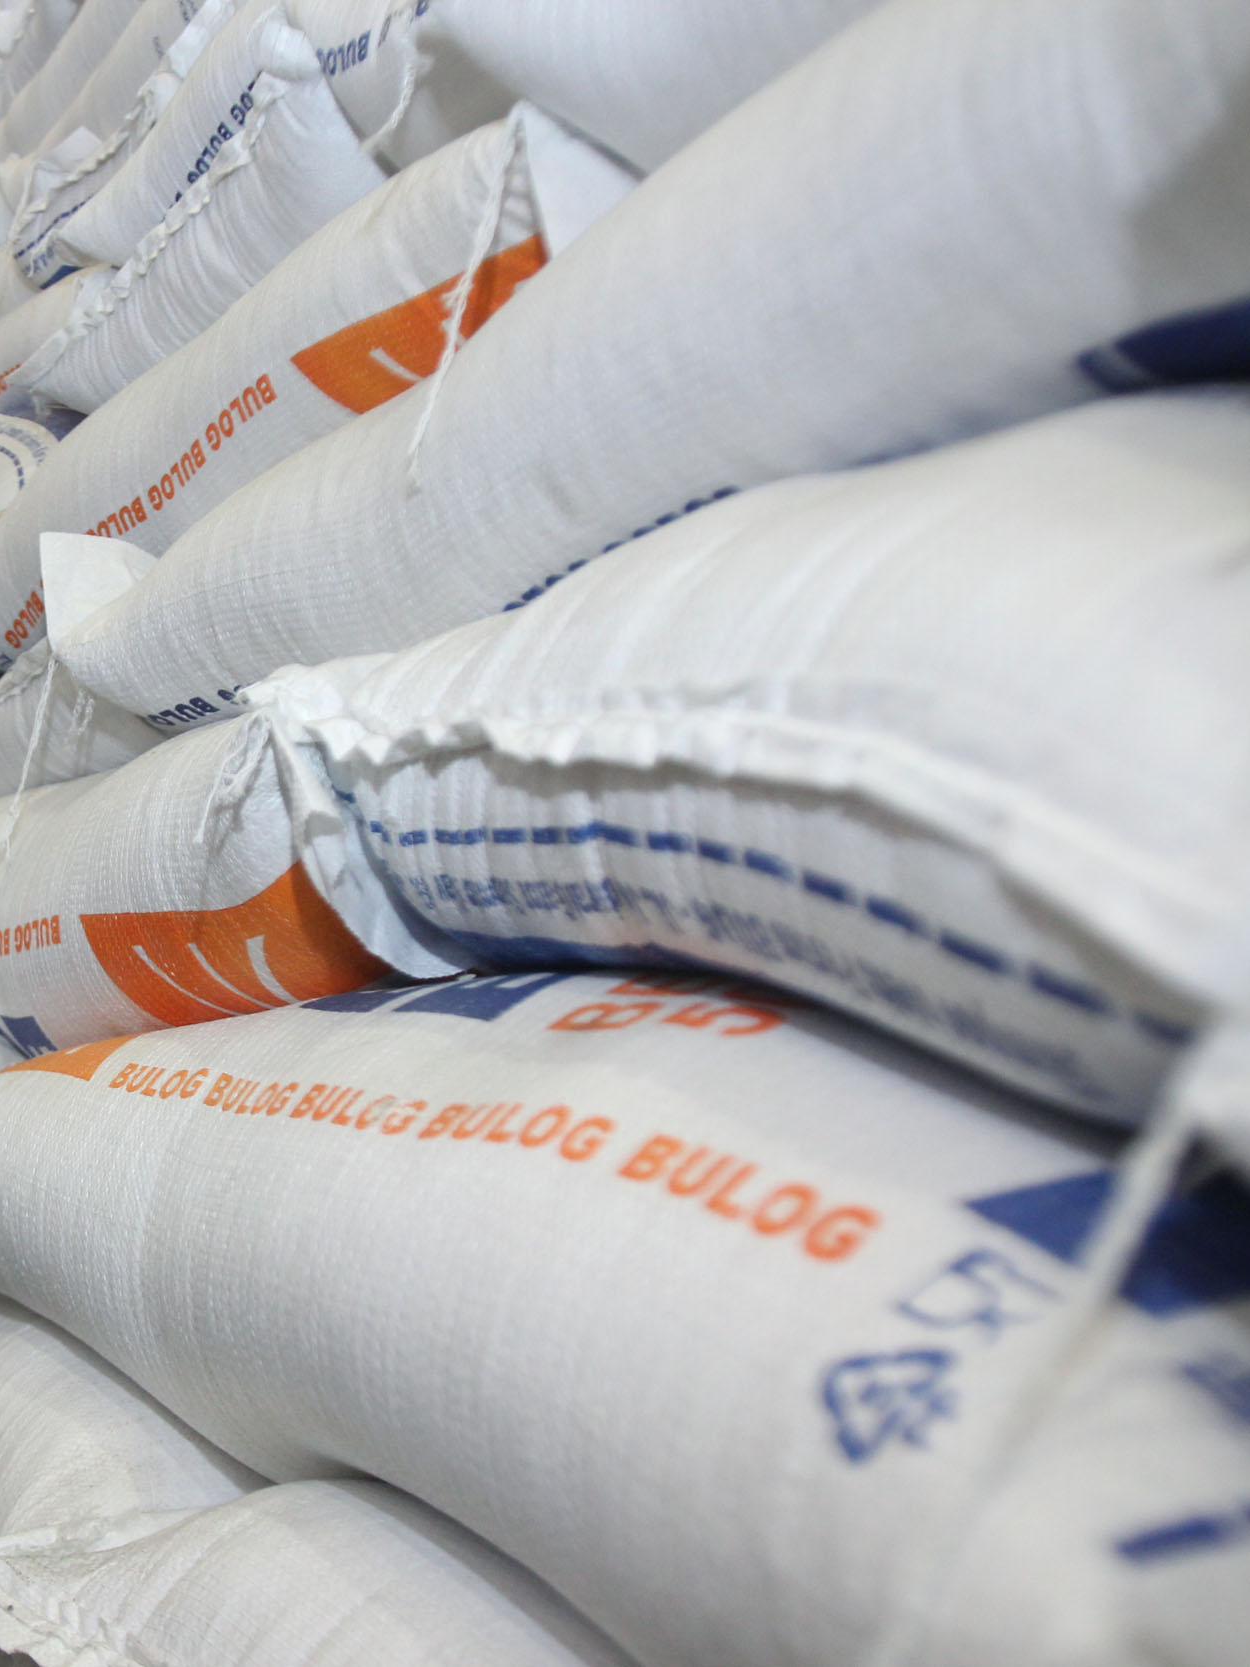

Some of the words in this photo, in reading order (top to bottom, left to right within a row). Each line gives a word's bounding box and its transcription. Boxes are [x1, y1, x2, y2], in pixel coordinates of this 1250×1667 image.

[187, 121, 234, 184] BULOG
[205, 373, 277, 451] BULOG
[147, 439, 207, 511] BULOG
[86, 496, 147, 538] BULO
[147, 696, 220, 726] BULO
[14, 914, 61, 953] BULOG
[108, 1062, 209, 1101] BULOG
[203, 1072, 299, 1118] BULOG
[289, 1083, 427, 1136] BULOG
[417, 1103, 616, 1163] BULOG
[616, 1132, 882, 1263] BULOG
